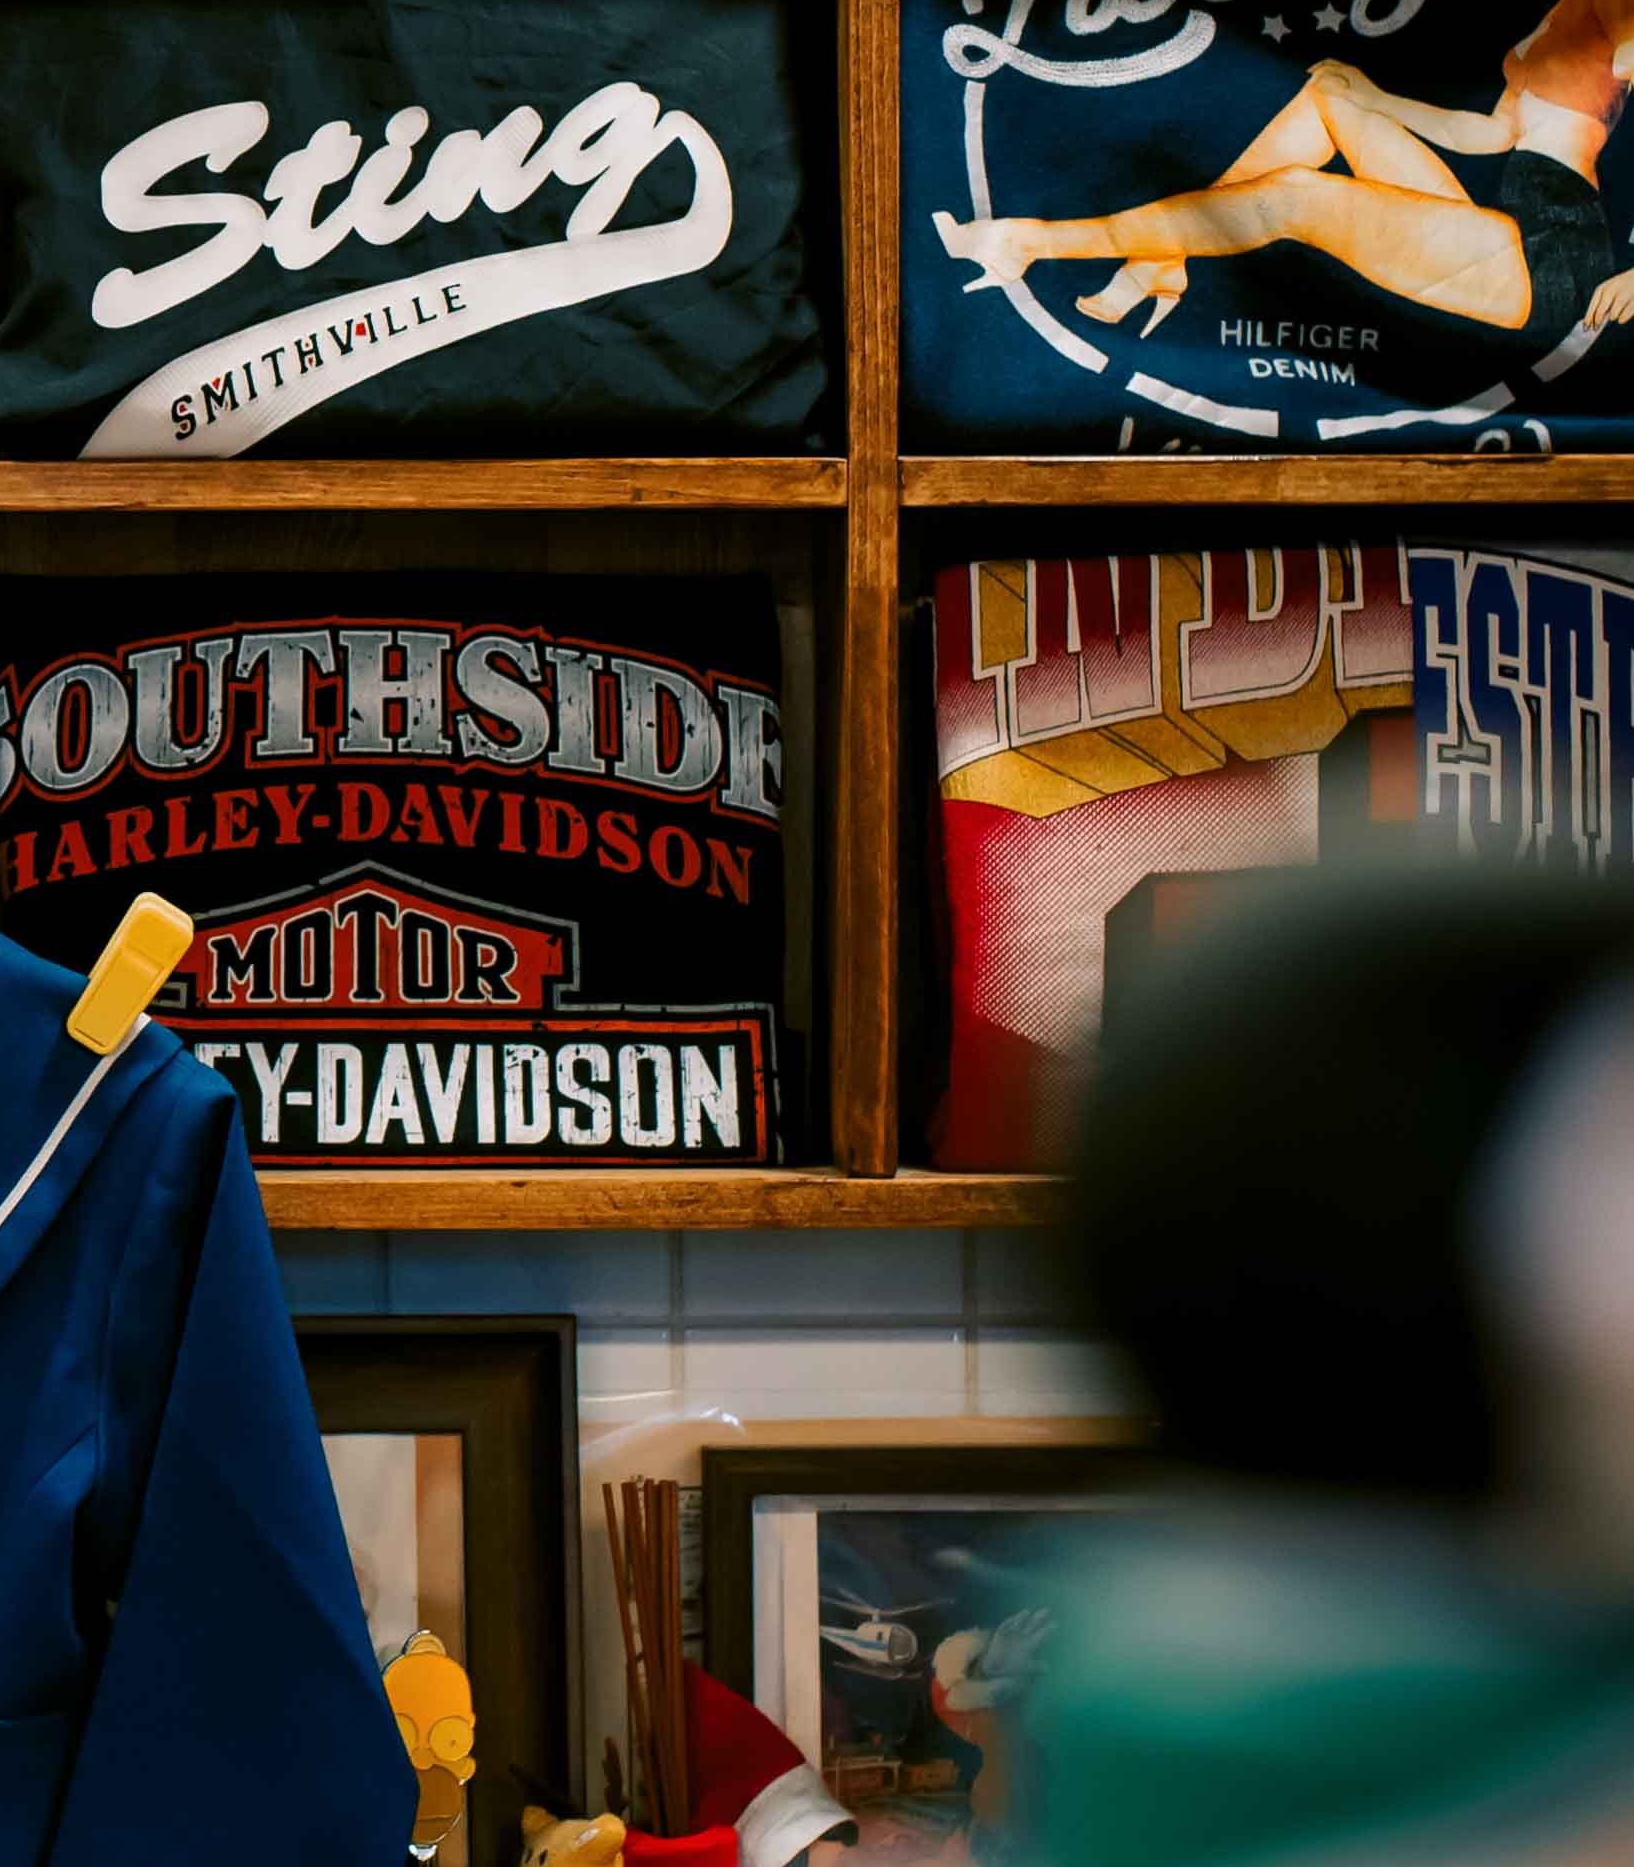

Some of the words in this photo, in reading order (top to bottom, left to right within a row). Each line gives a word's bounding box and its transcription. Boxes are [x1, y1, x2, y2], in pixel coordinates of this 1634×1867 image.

[92, 82, 732, 331] Sting
[171, 283, 470, 442] SMITHVILLE
[1219, 317, 1381, 352] HILFIGER
[1247, 357, 1357, 386] DENIM
[0, 780, 755, 906] HARLEY-DAVIDSON
[205, 889, 522, 1005] MOTOR
